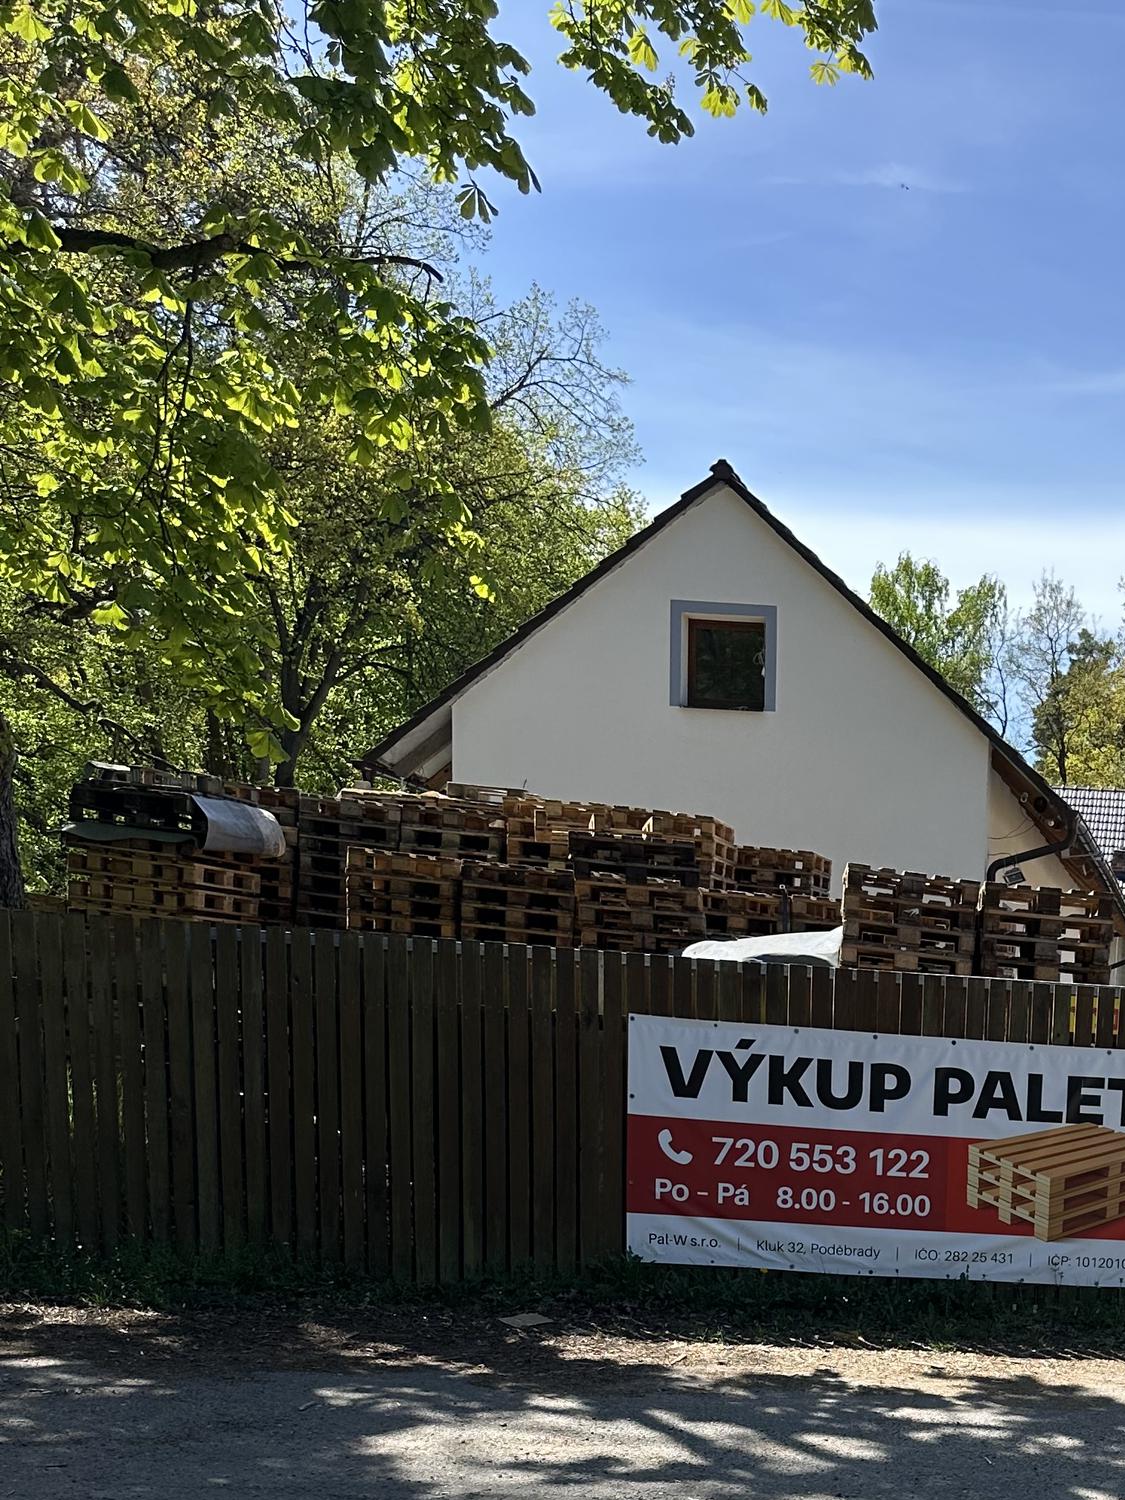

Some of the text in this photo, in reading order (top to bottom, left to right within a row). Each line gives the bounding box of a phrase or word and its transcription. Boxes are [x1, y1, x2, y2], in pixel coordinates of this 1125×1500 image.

[660, 1038, 911, 1113] VÝKUP
[711, 1136, 930, 1178] 720 553 122
[655, 1178, 689, 1202] Po
[717, 1182, 750, 1206] Pá
[776, 1186, 836, 1212] 8.00
[859, 1192, 931, 1217] 16.00
[648, 1233, 880, 1260] Pal-W s.r.o. Kluk 32, Poděbrady
[944, 1250, 968, 1263] 282
[971, 1252, 987, 1264] 25
[991, 1253, 1013, 1265] 431
